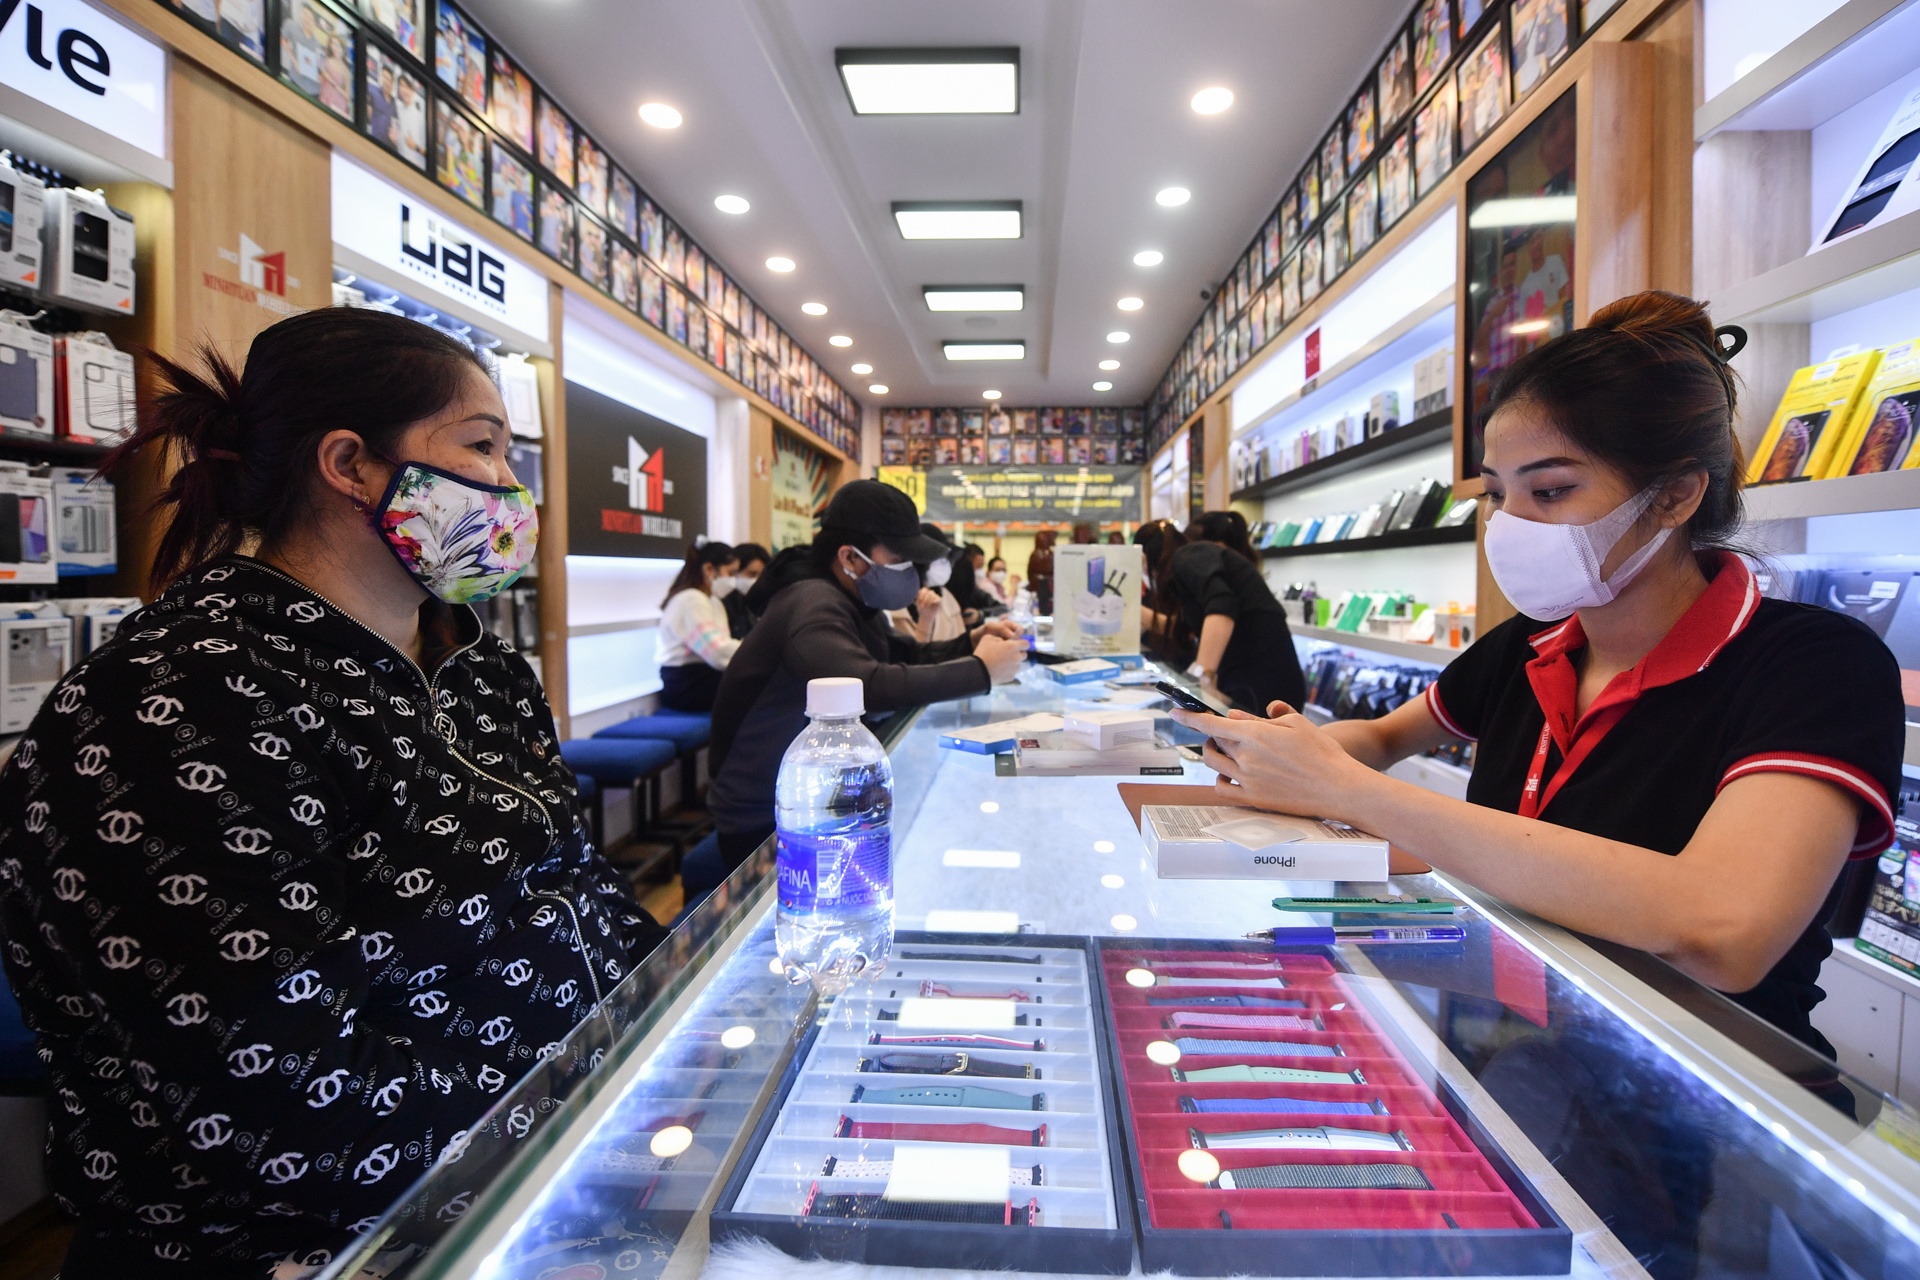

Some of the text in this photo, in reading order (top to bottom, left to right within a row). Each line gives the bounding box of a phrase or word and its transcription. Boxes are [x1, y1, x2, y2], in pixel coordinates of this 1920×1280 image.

[141, 671, 187, 695] CHANEL
[251, 713, 290, 728] CHANEL
[170, 735, 216, 758] CHANEL
[368, 759, 382, 792] CHANEL
[415, 754, 426, 780] CHANEL
[218, 803, 255, 826] CHANEL
[403, 802, 419, 830] CHANEL
[452, 826, 467, 855] CHANEL
[145, 845, 186, 876] CHANEL
[271, 857, 311, 882] CHANEL
[361, 852, 388, 883] CHANEL
[504, 851, 521, 882] CHANEL
[1253, 855, 1296, 868] iPhone
[422, 884, 447, 920] CHANEL
[209, 901, 248, 936] CHANEL
[548, 915, 565, 945] CHANEL
[274, 949, 314, 985] CHANEL
[371, 951, 404, 987] CHANEL
[330, 988, 348, 1017] CHANEL
[528, 973, 544, 1004] CHANEL
[444, 1005, 465, 1038] CHANEL
[507, 1032, 521, 1062] CHANEL
[290, 1047, 321, 1090] CHANEL
[361, 1064, 377, 1106] CHANEL
[246, 1127, 274, 1170] CHANEL
[423, 1126, 434, 1168] CHANEL
